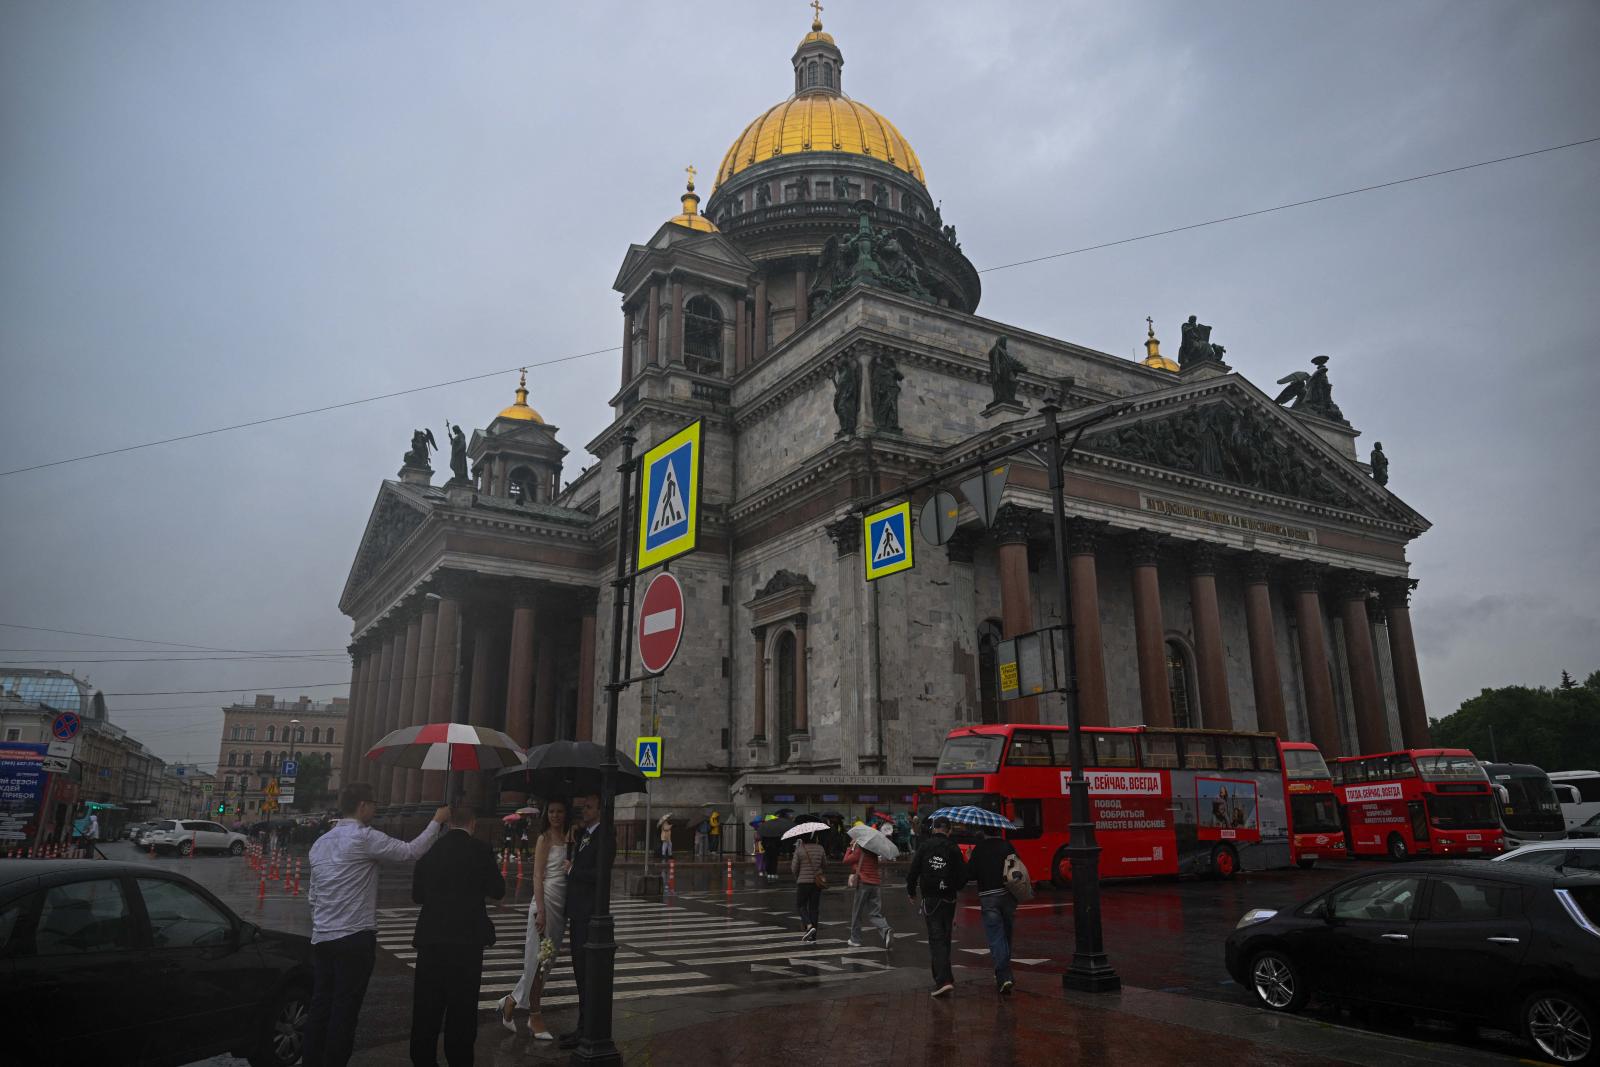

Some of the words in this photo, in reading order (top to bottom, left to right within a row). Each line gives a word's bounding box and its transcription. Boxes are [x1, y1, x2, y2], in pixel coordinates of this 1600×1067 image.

[1095, 774, 1128, 791] СЕЙЧАС,
[1129, 777, 1158, 791] ВСЕГДА
[1095, 800, 1121, 808] ПОВОД
[1100, 810, 1144, 818] СОБРАТЬСЯ
[1096, 820, 1127, 829] ВМЕСТЕ
[1128, 820, 1133, 829] В
[1134, 819, 1166, 829] МОСКВЕ
